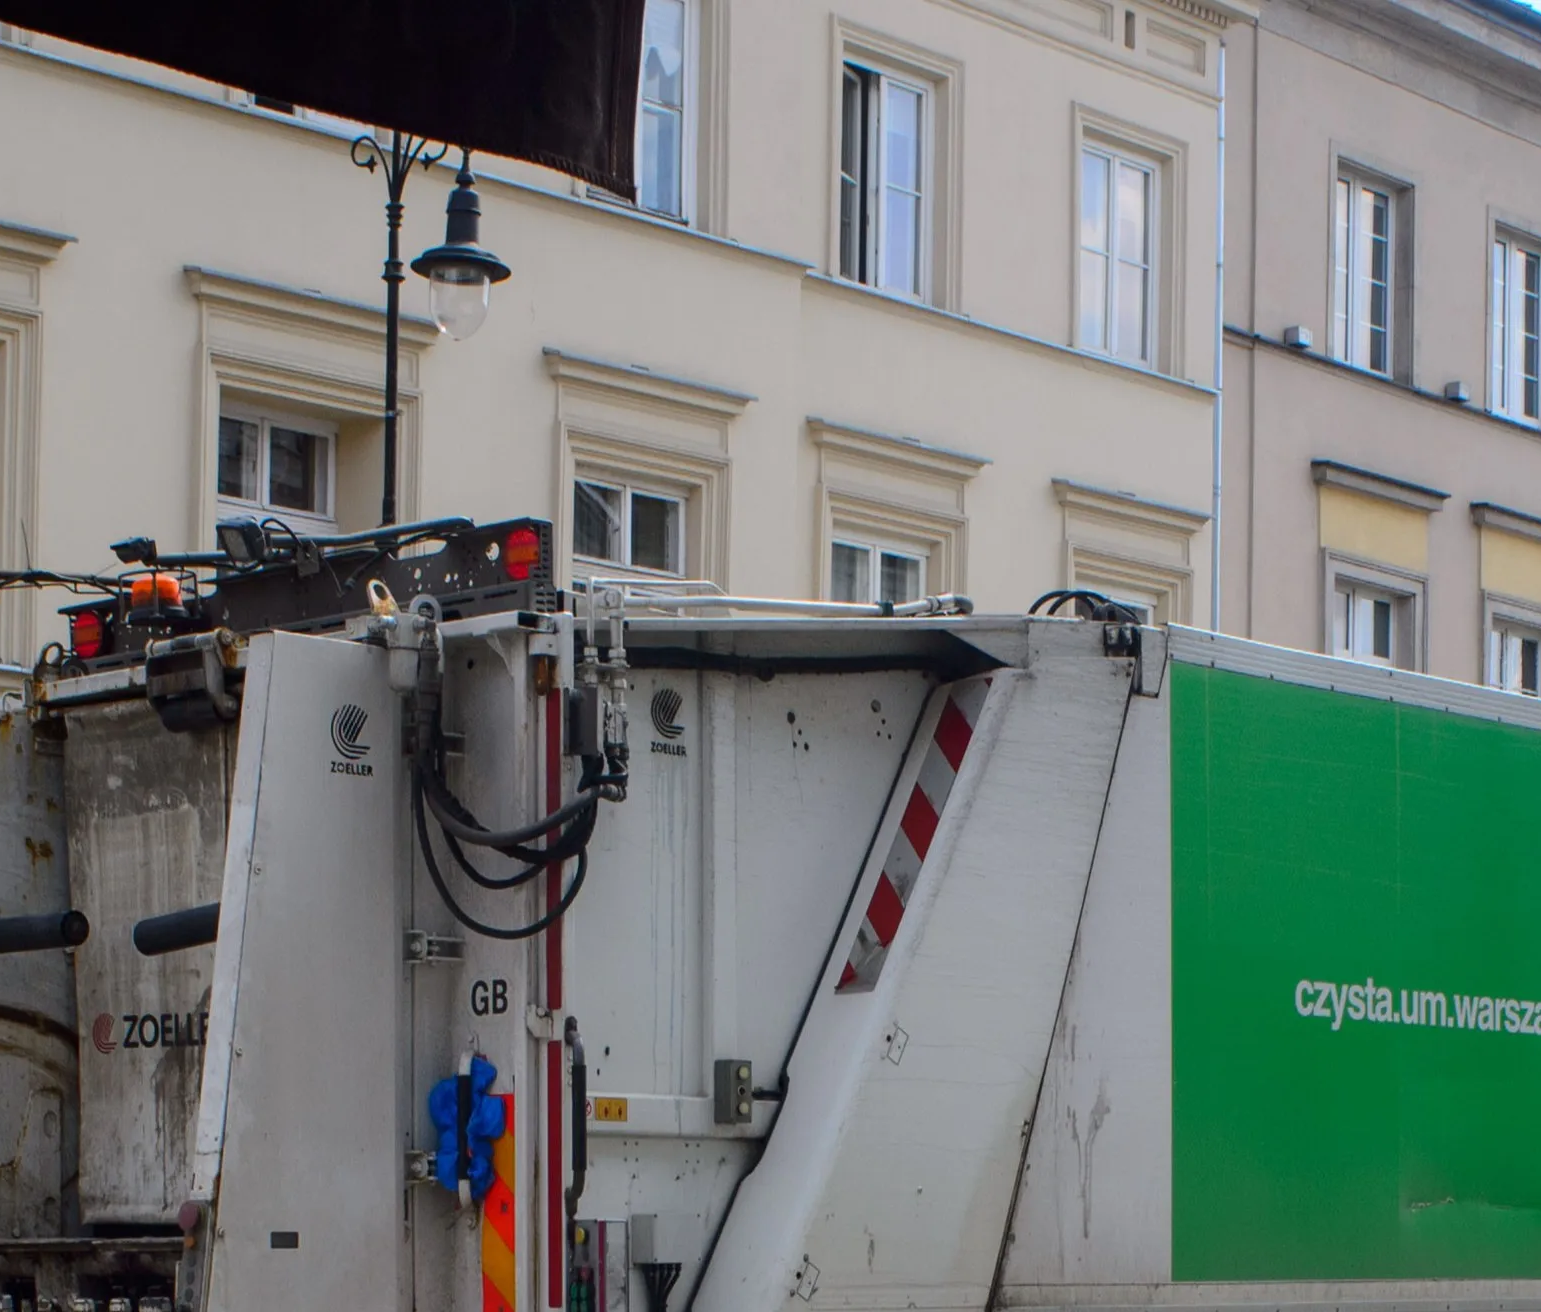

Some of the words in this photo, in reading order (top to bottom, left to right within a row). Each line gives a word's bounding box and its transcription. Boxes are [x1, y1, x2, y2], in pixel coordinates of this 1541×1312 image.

[651, 741, 687, 757] ZOELLER
[331, 761, 374, 777] ZOELLER
[471, 979, 508, 1016] GB
[122, 1012, 209, 1049] ZOELLE
